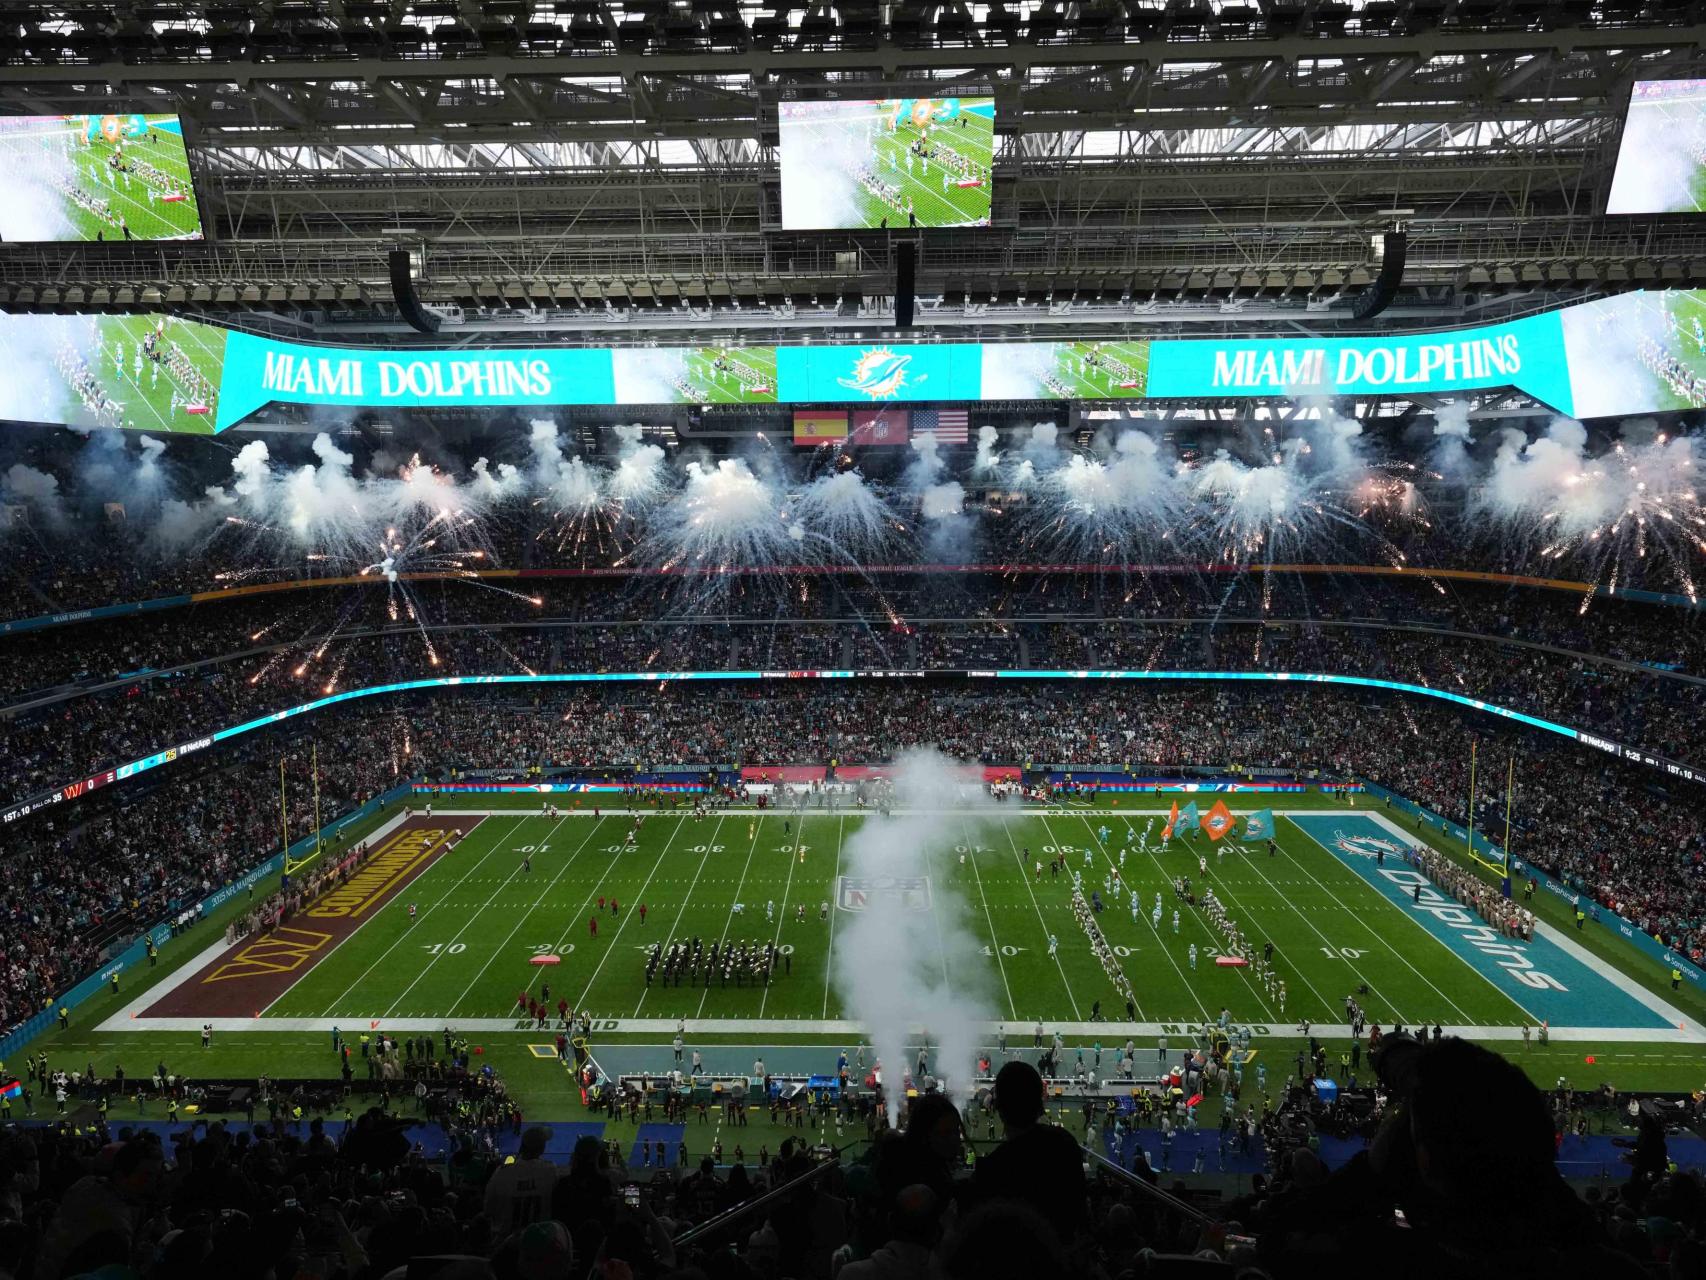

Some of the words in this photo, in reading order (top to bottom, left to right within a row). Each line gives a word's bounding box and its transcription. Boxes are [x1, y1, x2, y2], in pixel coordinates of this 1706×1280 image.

[1212, 349, 1323, 387] MIAMI
[1336, 334, 1521, 385] DOLPHINS
[262, 350, 363, 396] MIAMI
[380, 360, 551, 397] DOLPHINS
[187, 738, 211, 753] NetApp
[1589, 738, 1615, 752] NetApp
[167, 750, 176, 760] 25
[1625, 750, 1641, 762] 9:25
[1667, 764, 1680, 776] 1ST
[1684, 771, 1693, 780] 10
[3, 810, 18, 823] 1ST
[21, 806, 30, 816] 10
[52, 793, 63, 803] 35
[307, 829, 442, 918] COMMANDERS
[212, 892, 226, 907] 2025
[237, 871, 258, 890] MADRID
[257, 862, 273, 878] GAME
[1545, 880, 1576, 902] Dolphins
[1620, 924, 1633, 938] VISA
[426, 943, 467, 954] 10
[533, 943, 576, 955] 20
[977, 945, 1018, 956] 40
[1203, 946, 1245, 958] 20
[1320, 947, 1361, 959] 10
[1670, 957, 1700, 981] Santander
[514, 1020, 619, 1031] MADID
